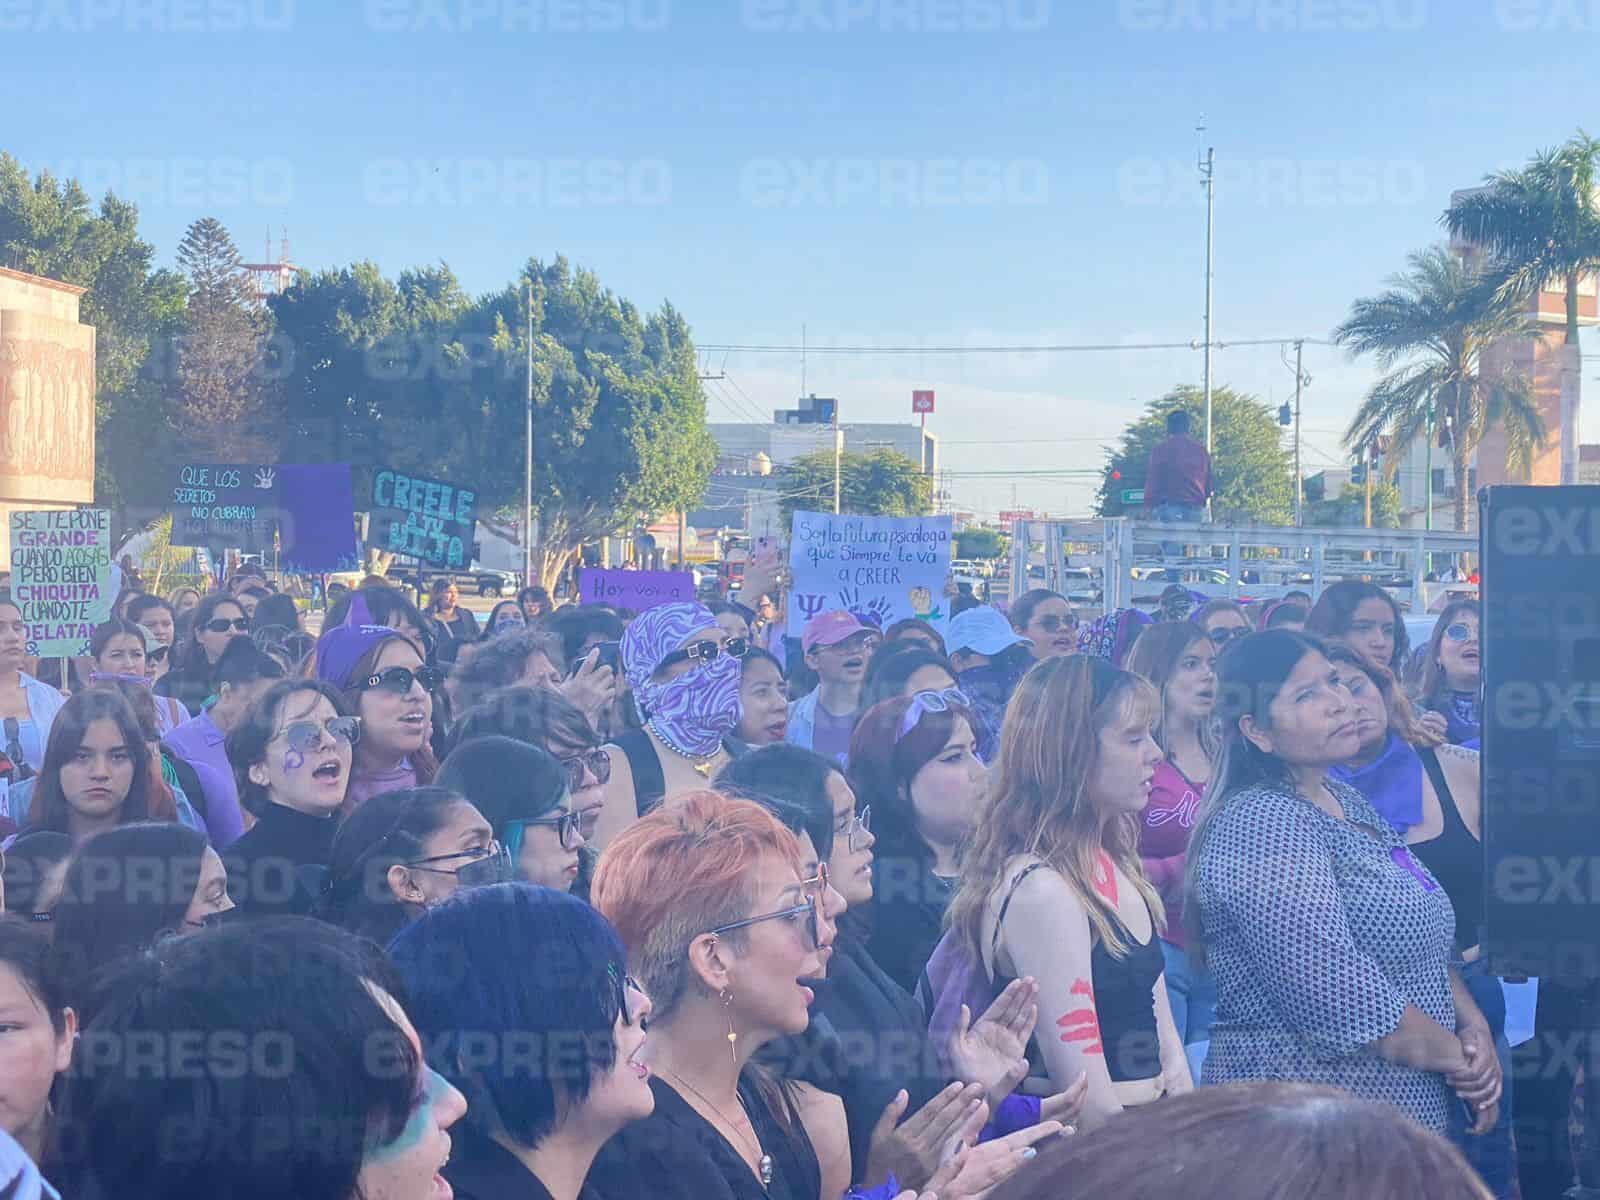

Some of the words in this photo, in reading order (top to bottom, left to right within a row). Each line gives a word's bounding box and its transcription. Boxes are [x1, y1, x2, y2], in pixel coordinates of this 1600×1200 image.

[181, 466, 209, 486] QUE
[215, 470, 241, 488] LOS
[375, 471, 475, 526] CREELE
[12, 511, 37, 530] SE
[192, 507, 208, 519] NO
[212, 506, 256, 519] CUBRAN
[19, 531, 100, 546] GRANDE
[11, 548, 62, 567] CUANDO
[807, 547, 834, 568] que
[20, 566, 58, 583] PERO
[62, 565, 97, 583] BIEN
[839, 569, 849, 581] a
[855, 567, 902, 585] CREER
[16, 584, 100, 601] CHIQUITA
